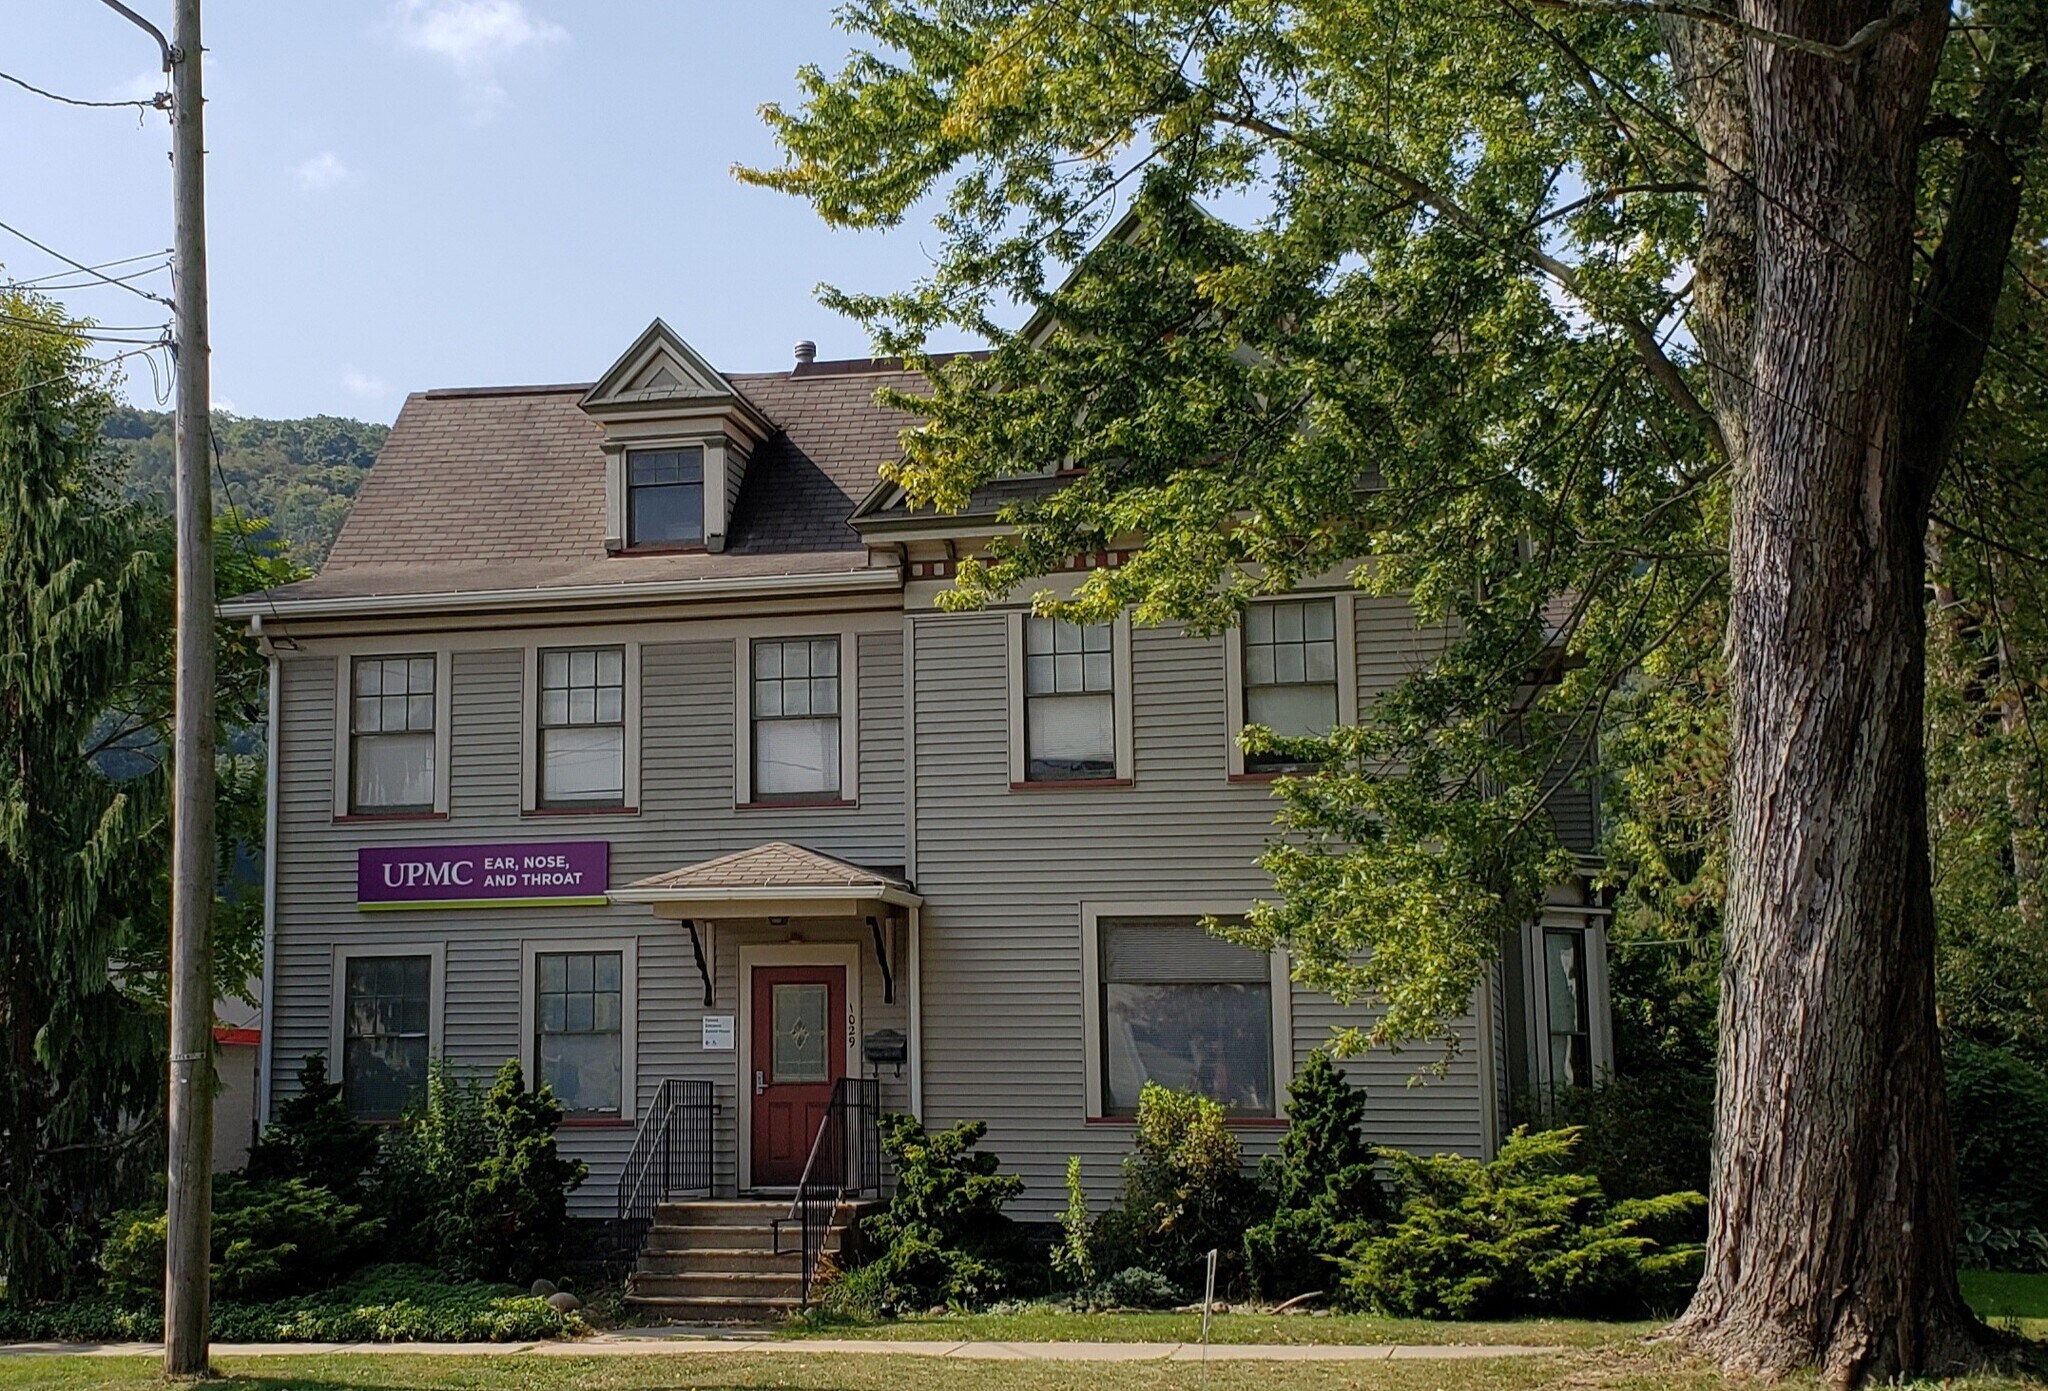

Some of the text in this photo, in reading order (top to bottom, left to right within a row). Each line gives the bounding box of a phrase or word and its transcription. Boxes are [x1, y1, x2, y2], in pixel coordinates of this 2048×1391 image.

[484, 856, 571, 871] EAR, NOSE,
[382, 861, 474, 888] UPMC
[484, 872, 584, 888] AND THROAT
[848, 1003, 857, 1049] 1029
